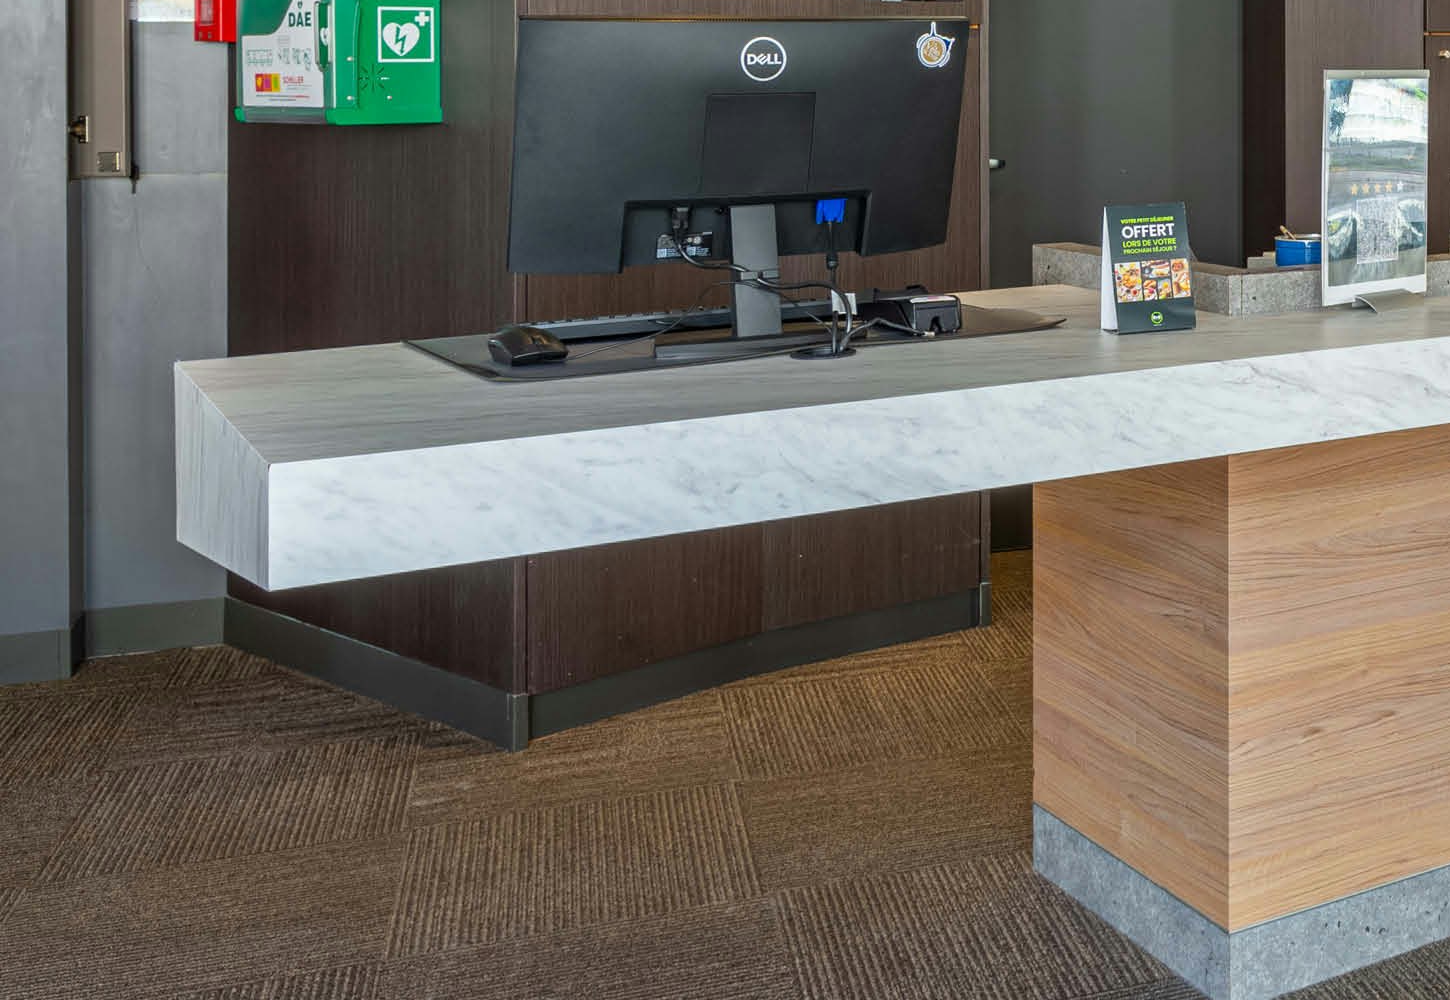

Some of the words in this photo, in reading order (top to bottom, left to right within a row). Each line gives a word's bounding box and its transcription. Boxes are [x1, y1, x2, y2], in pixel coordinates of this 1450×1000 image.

[288, 12, 312, 27] DAE
[747, 53, 782, 65] DELL
[1121, 223, 1175, 239] OFFERT
[1122, 239, 1141, 249] LORS
[1142, 239, 1152, 247] DE
[1152, 238, 1177, 246] VOTRE
